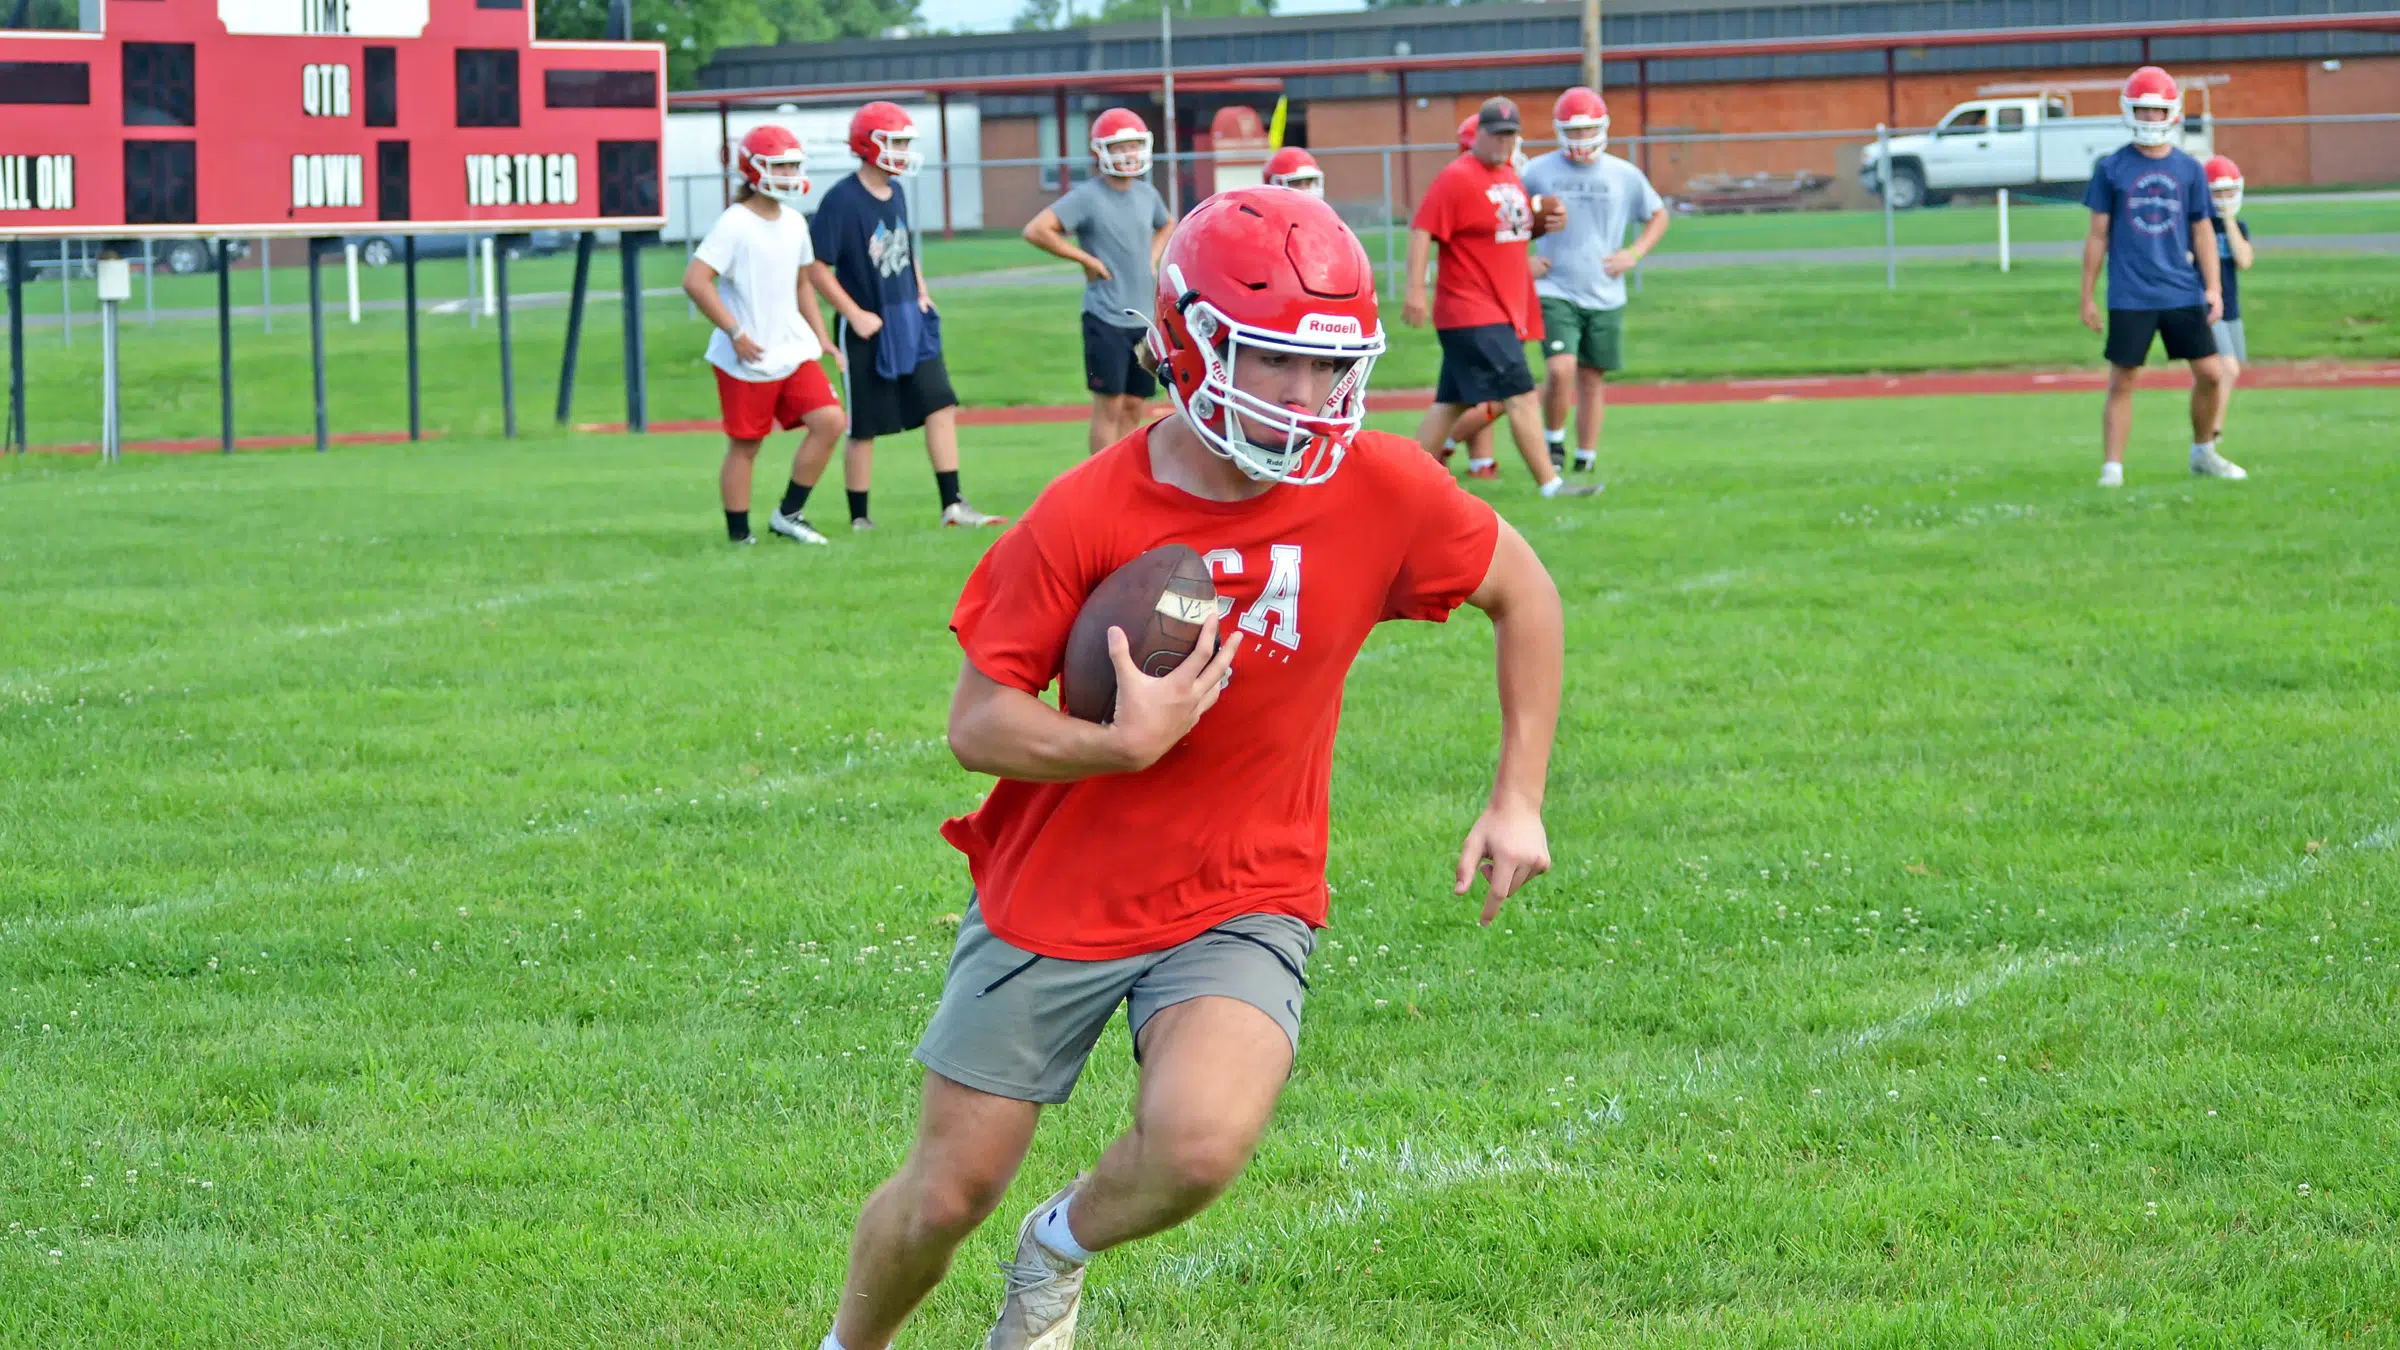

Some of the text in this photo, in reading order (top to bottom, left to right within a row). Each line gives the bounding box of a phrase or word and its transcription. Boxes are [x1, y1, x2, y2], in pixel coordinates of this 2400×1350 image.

[303, 63, 350, 117] QTR
[0, 154, 74, 210] LL ON
[291, 153, 363, 207] DOWN
[465, 153, 578, 206] YDS TO GO
[1309, 319, 1358, 334] Riddell
[1326, 368, 1359, 408] Riddell
